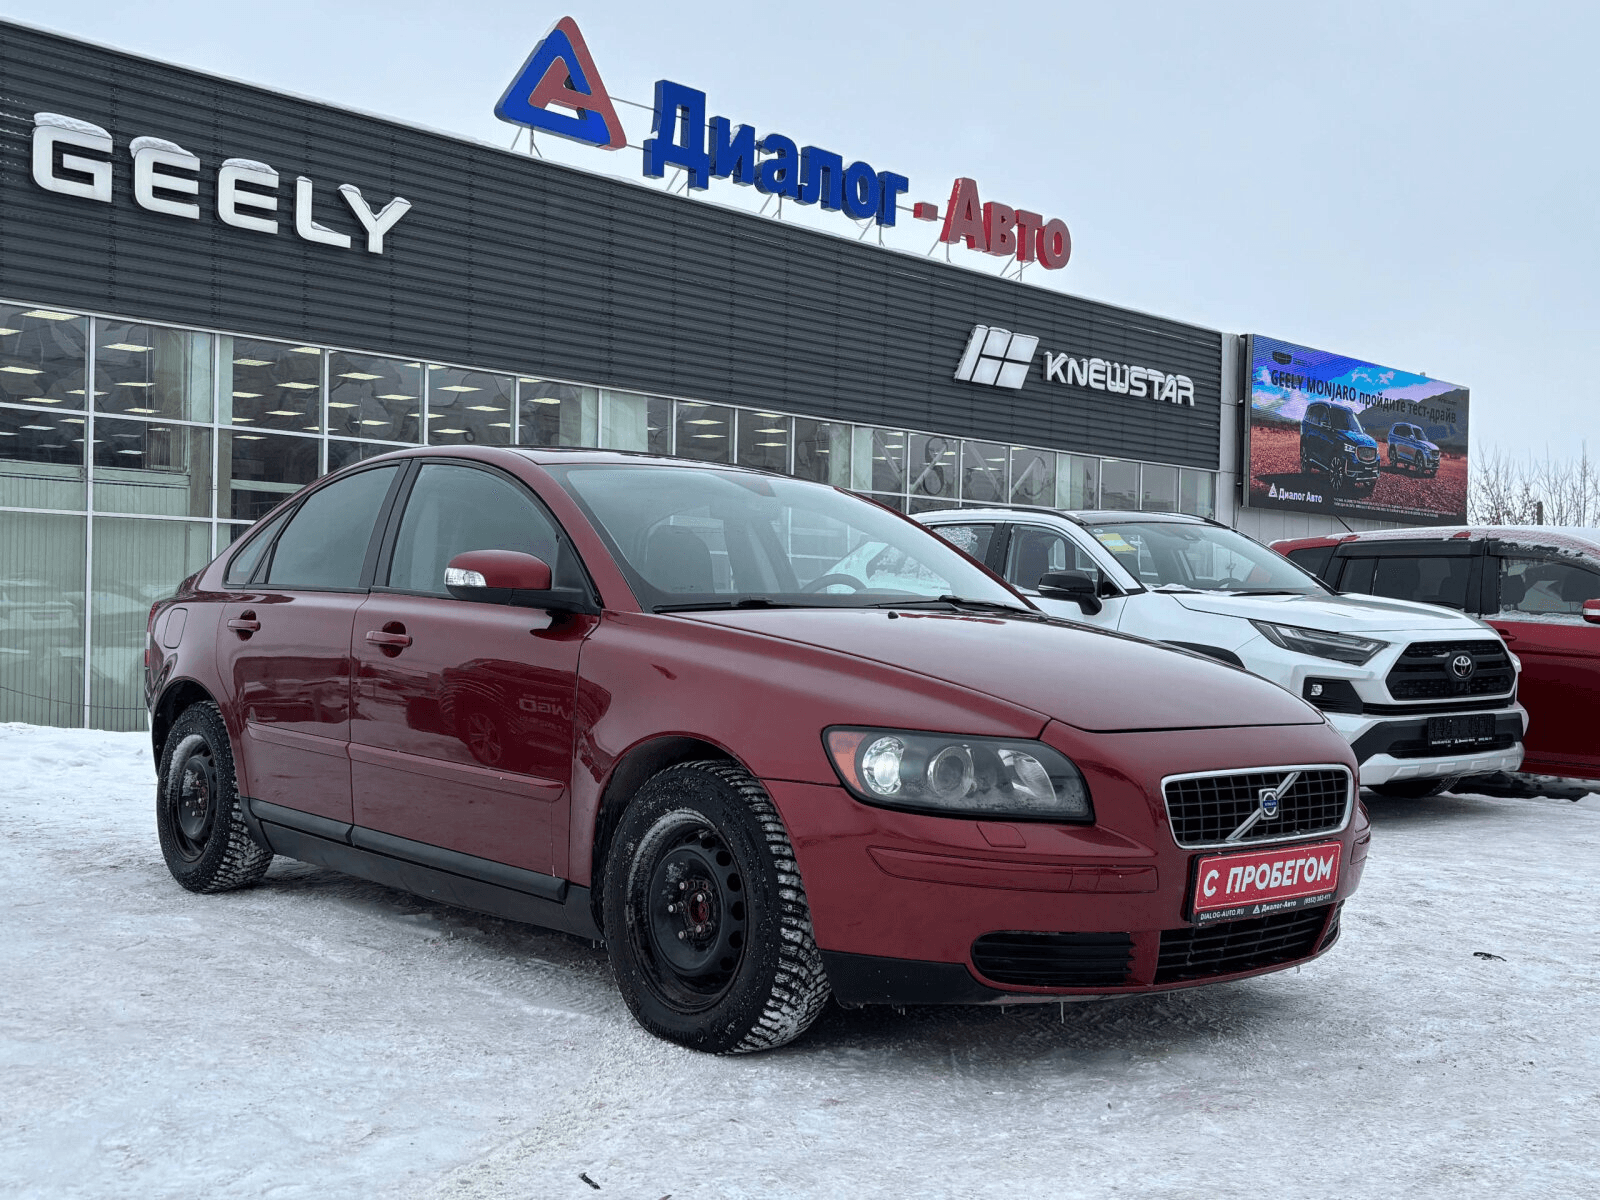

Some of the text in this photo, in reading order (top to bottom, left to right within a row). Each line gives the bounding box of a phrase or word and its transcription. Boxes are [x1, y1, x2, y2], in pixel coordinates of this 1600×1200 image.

[32, 119, 412, 255] GEELY
[1044, 351, 1195, 407] KNEWSTAR
[1271, 369, 1457, 425] GEELY MONJARO пройдите тест-драйв
[1278, 487, 1323, 503] Диалог Авто
[1203, 854, 1335, 897] С ПРОБЕГОМ
[1200, 908, 1245, 920] DIALOG-AUTO.RU
[1261, 900, 1297, 913] Диалог-Авто
